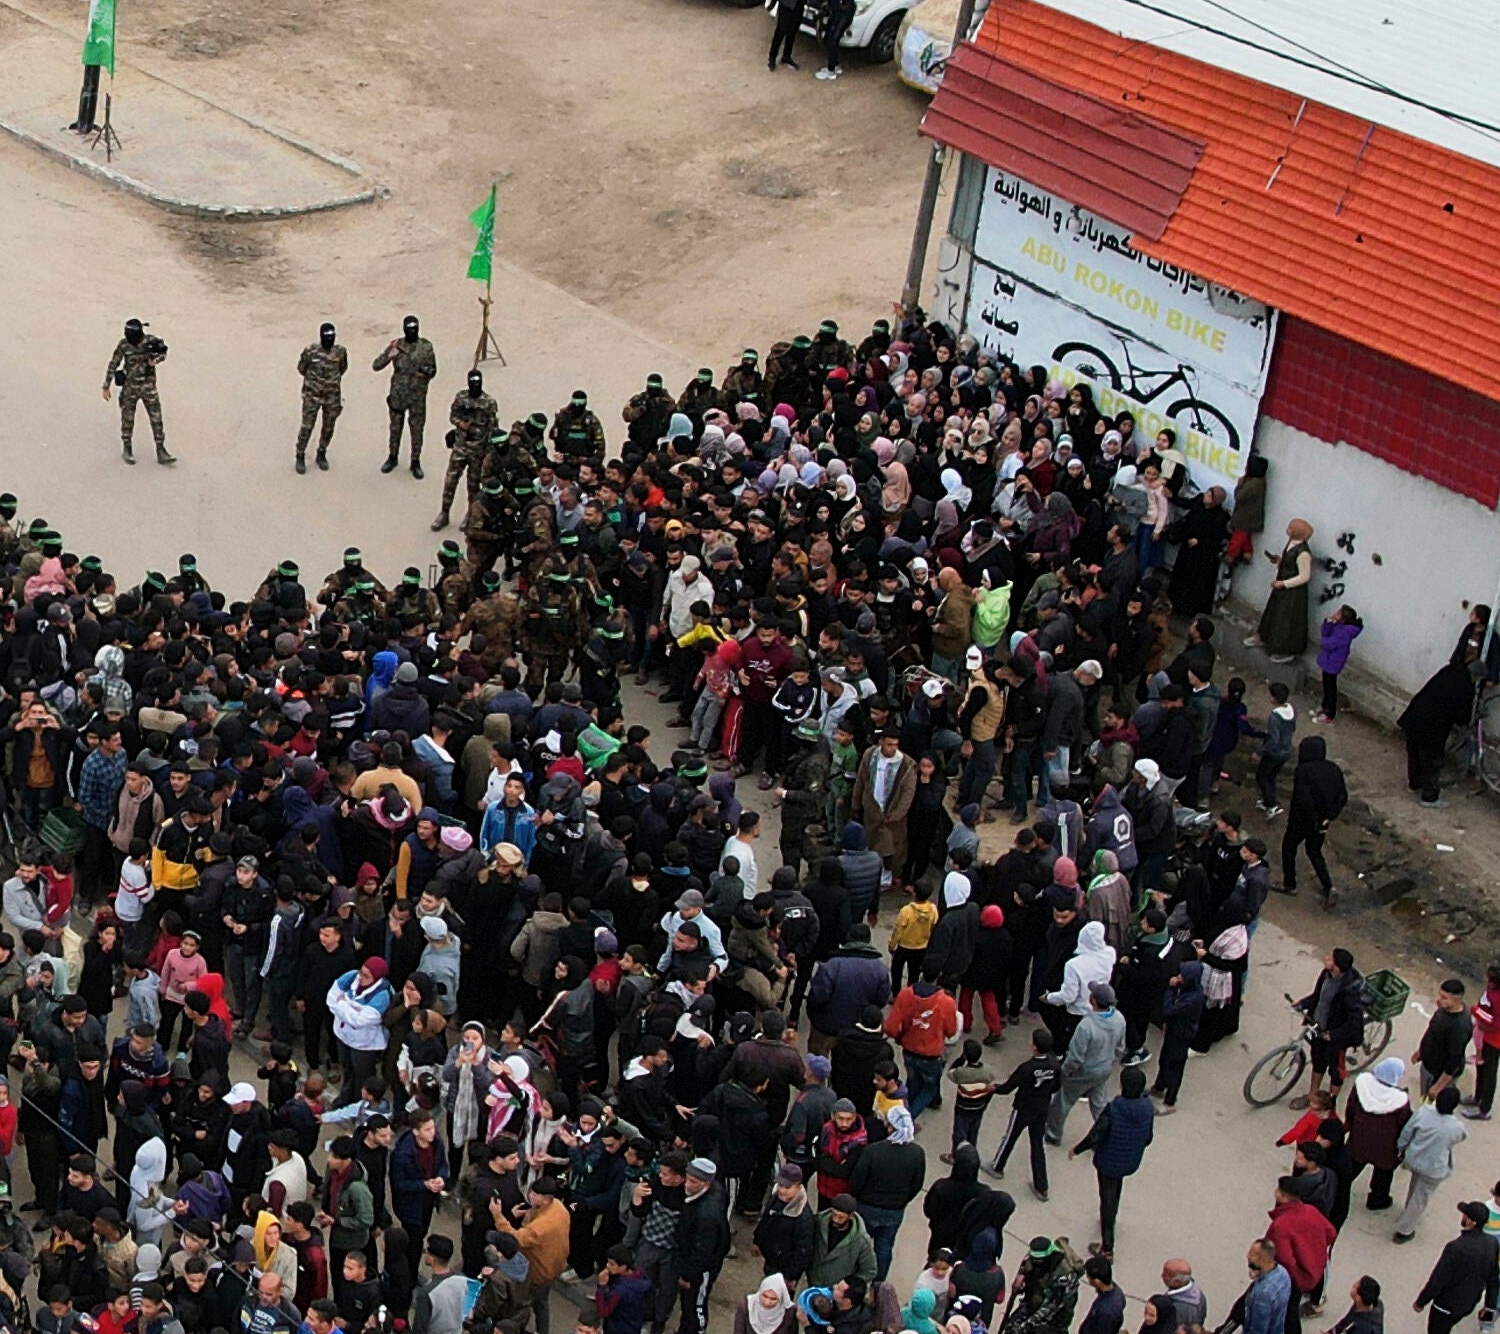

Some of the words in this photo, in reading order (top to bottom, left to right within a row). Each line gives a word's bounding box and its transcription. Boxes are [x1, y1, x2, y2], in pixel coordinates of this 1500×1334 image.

[1020, 236, 1067, 275] ABU
[1073, 262, 1160, 321] ROKON
[1165, 308, 1228, 353] BIKE
[1184, 431, 1240, 480] BIKE
